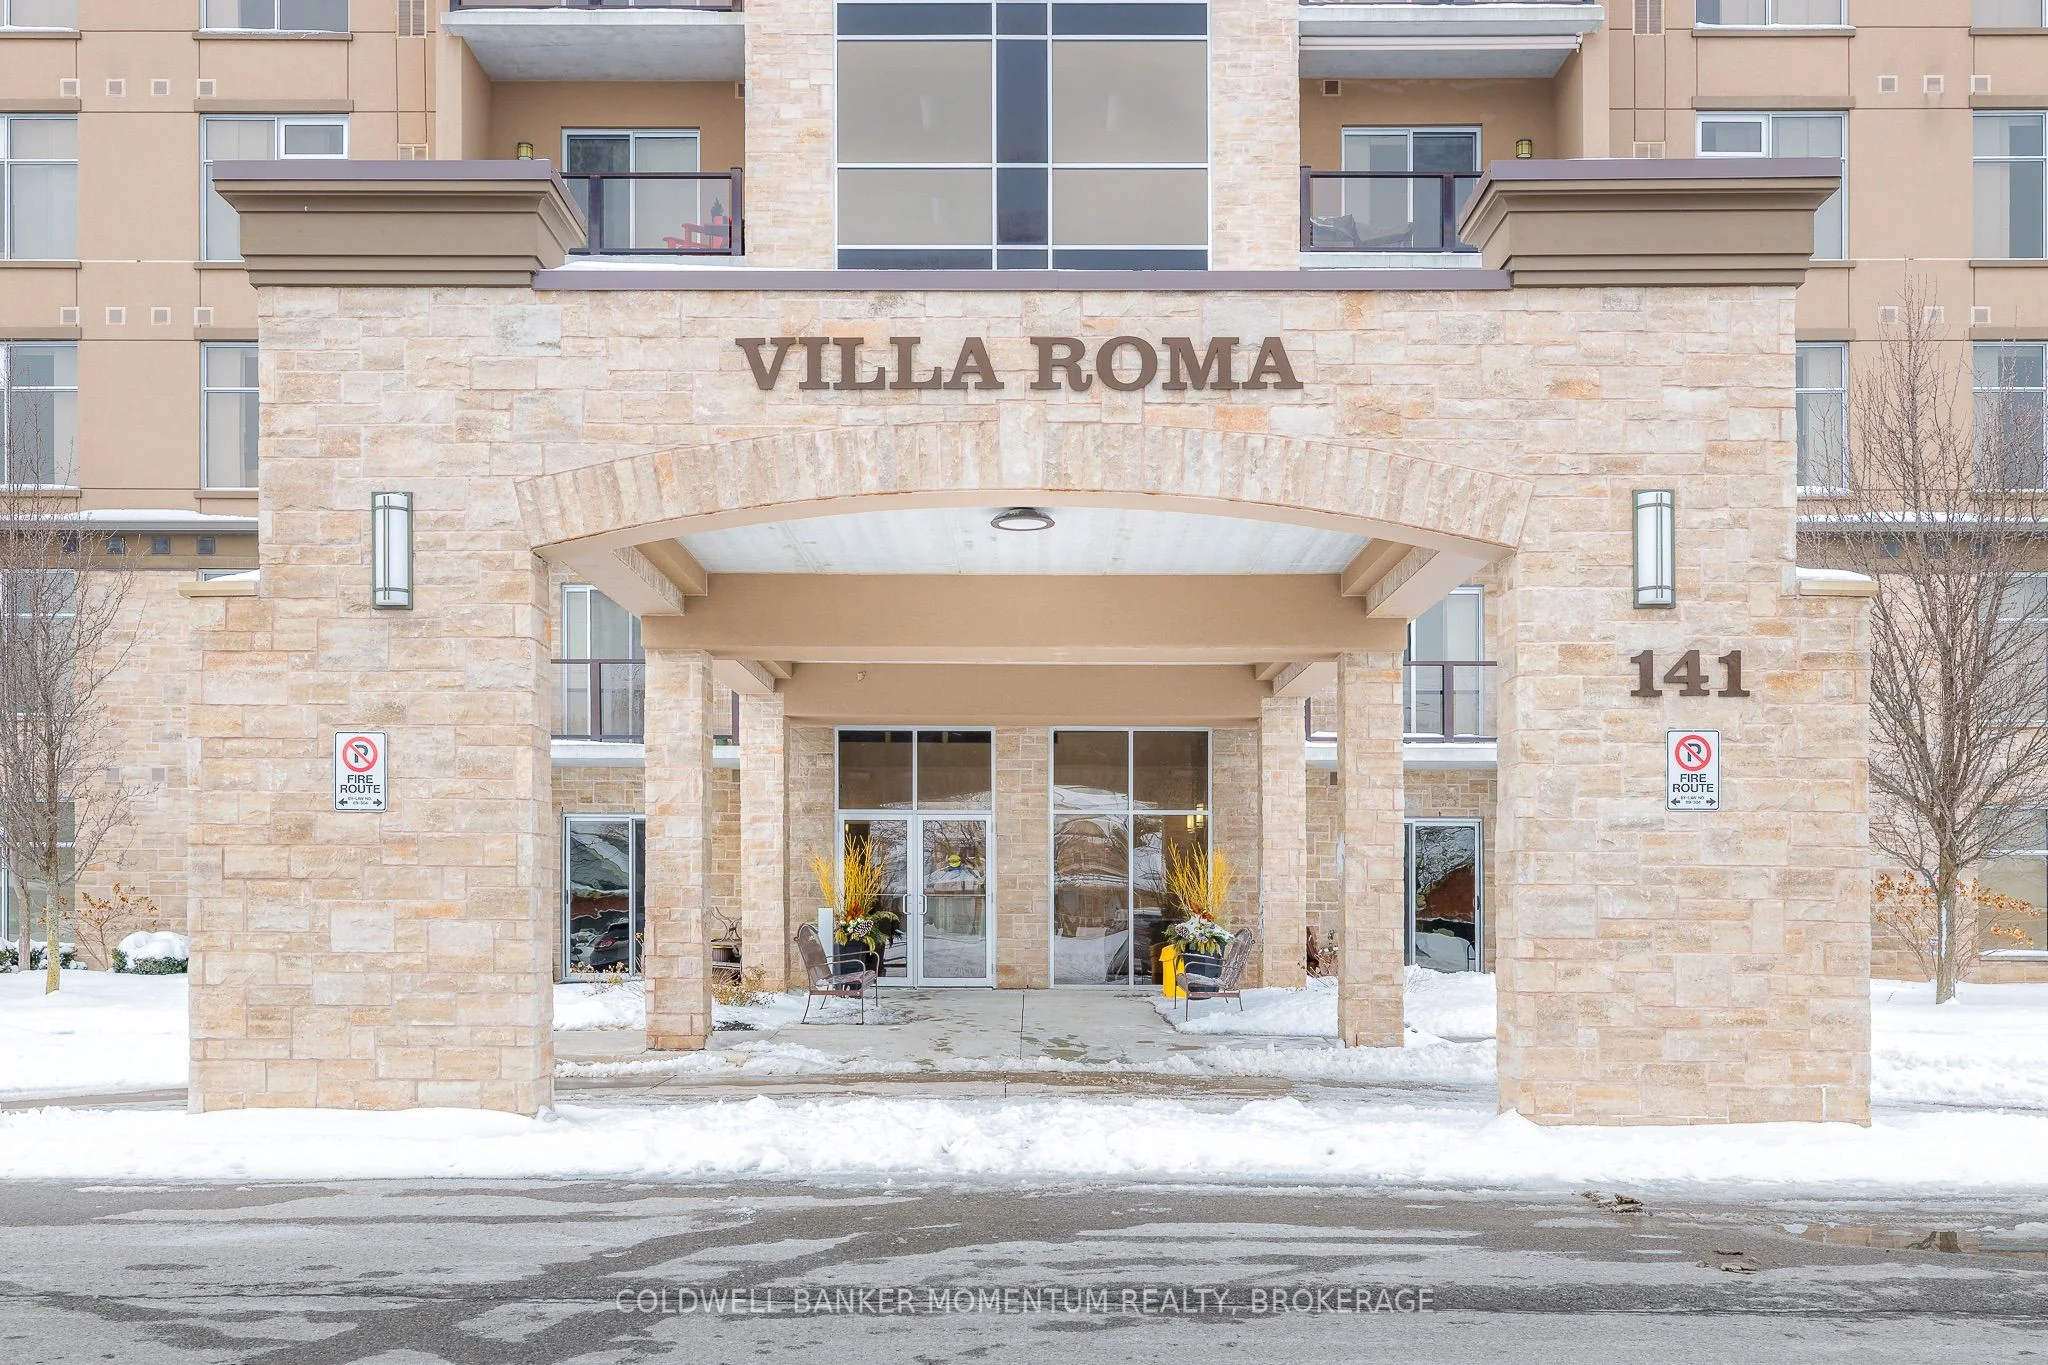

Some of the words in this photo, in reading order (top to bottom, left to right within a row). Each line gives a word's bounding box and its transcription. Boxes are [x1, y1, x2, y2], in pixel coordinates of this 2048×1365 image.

[736, 335, 1004, 391] VILLA
[1030, 335, 1303, 391] ROMA
[1630, 649, 1750, 697] 141
[347, 774, 374, 784] FIRE
[1680, 773, 1707, 783] FIRE
[340, 784, 381, 794] ROUTE
[1672, 783, 1714, 793] ROUTE
